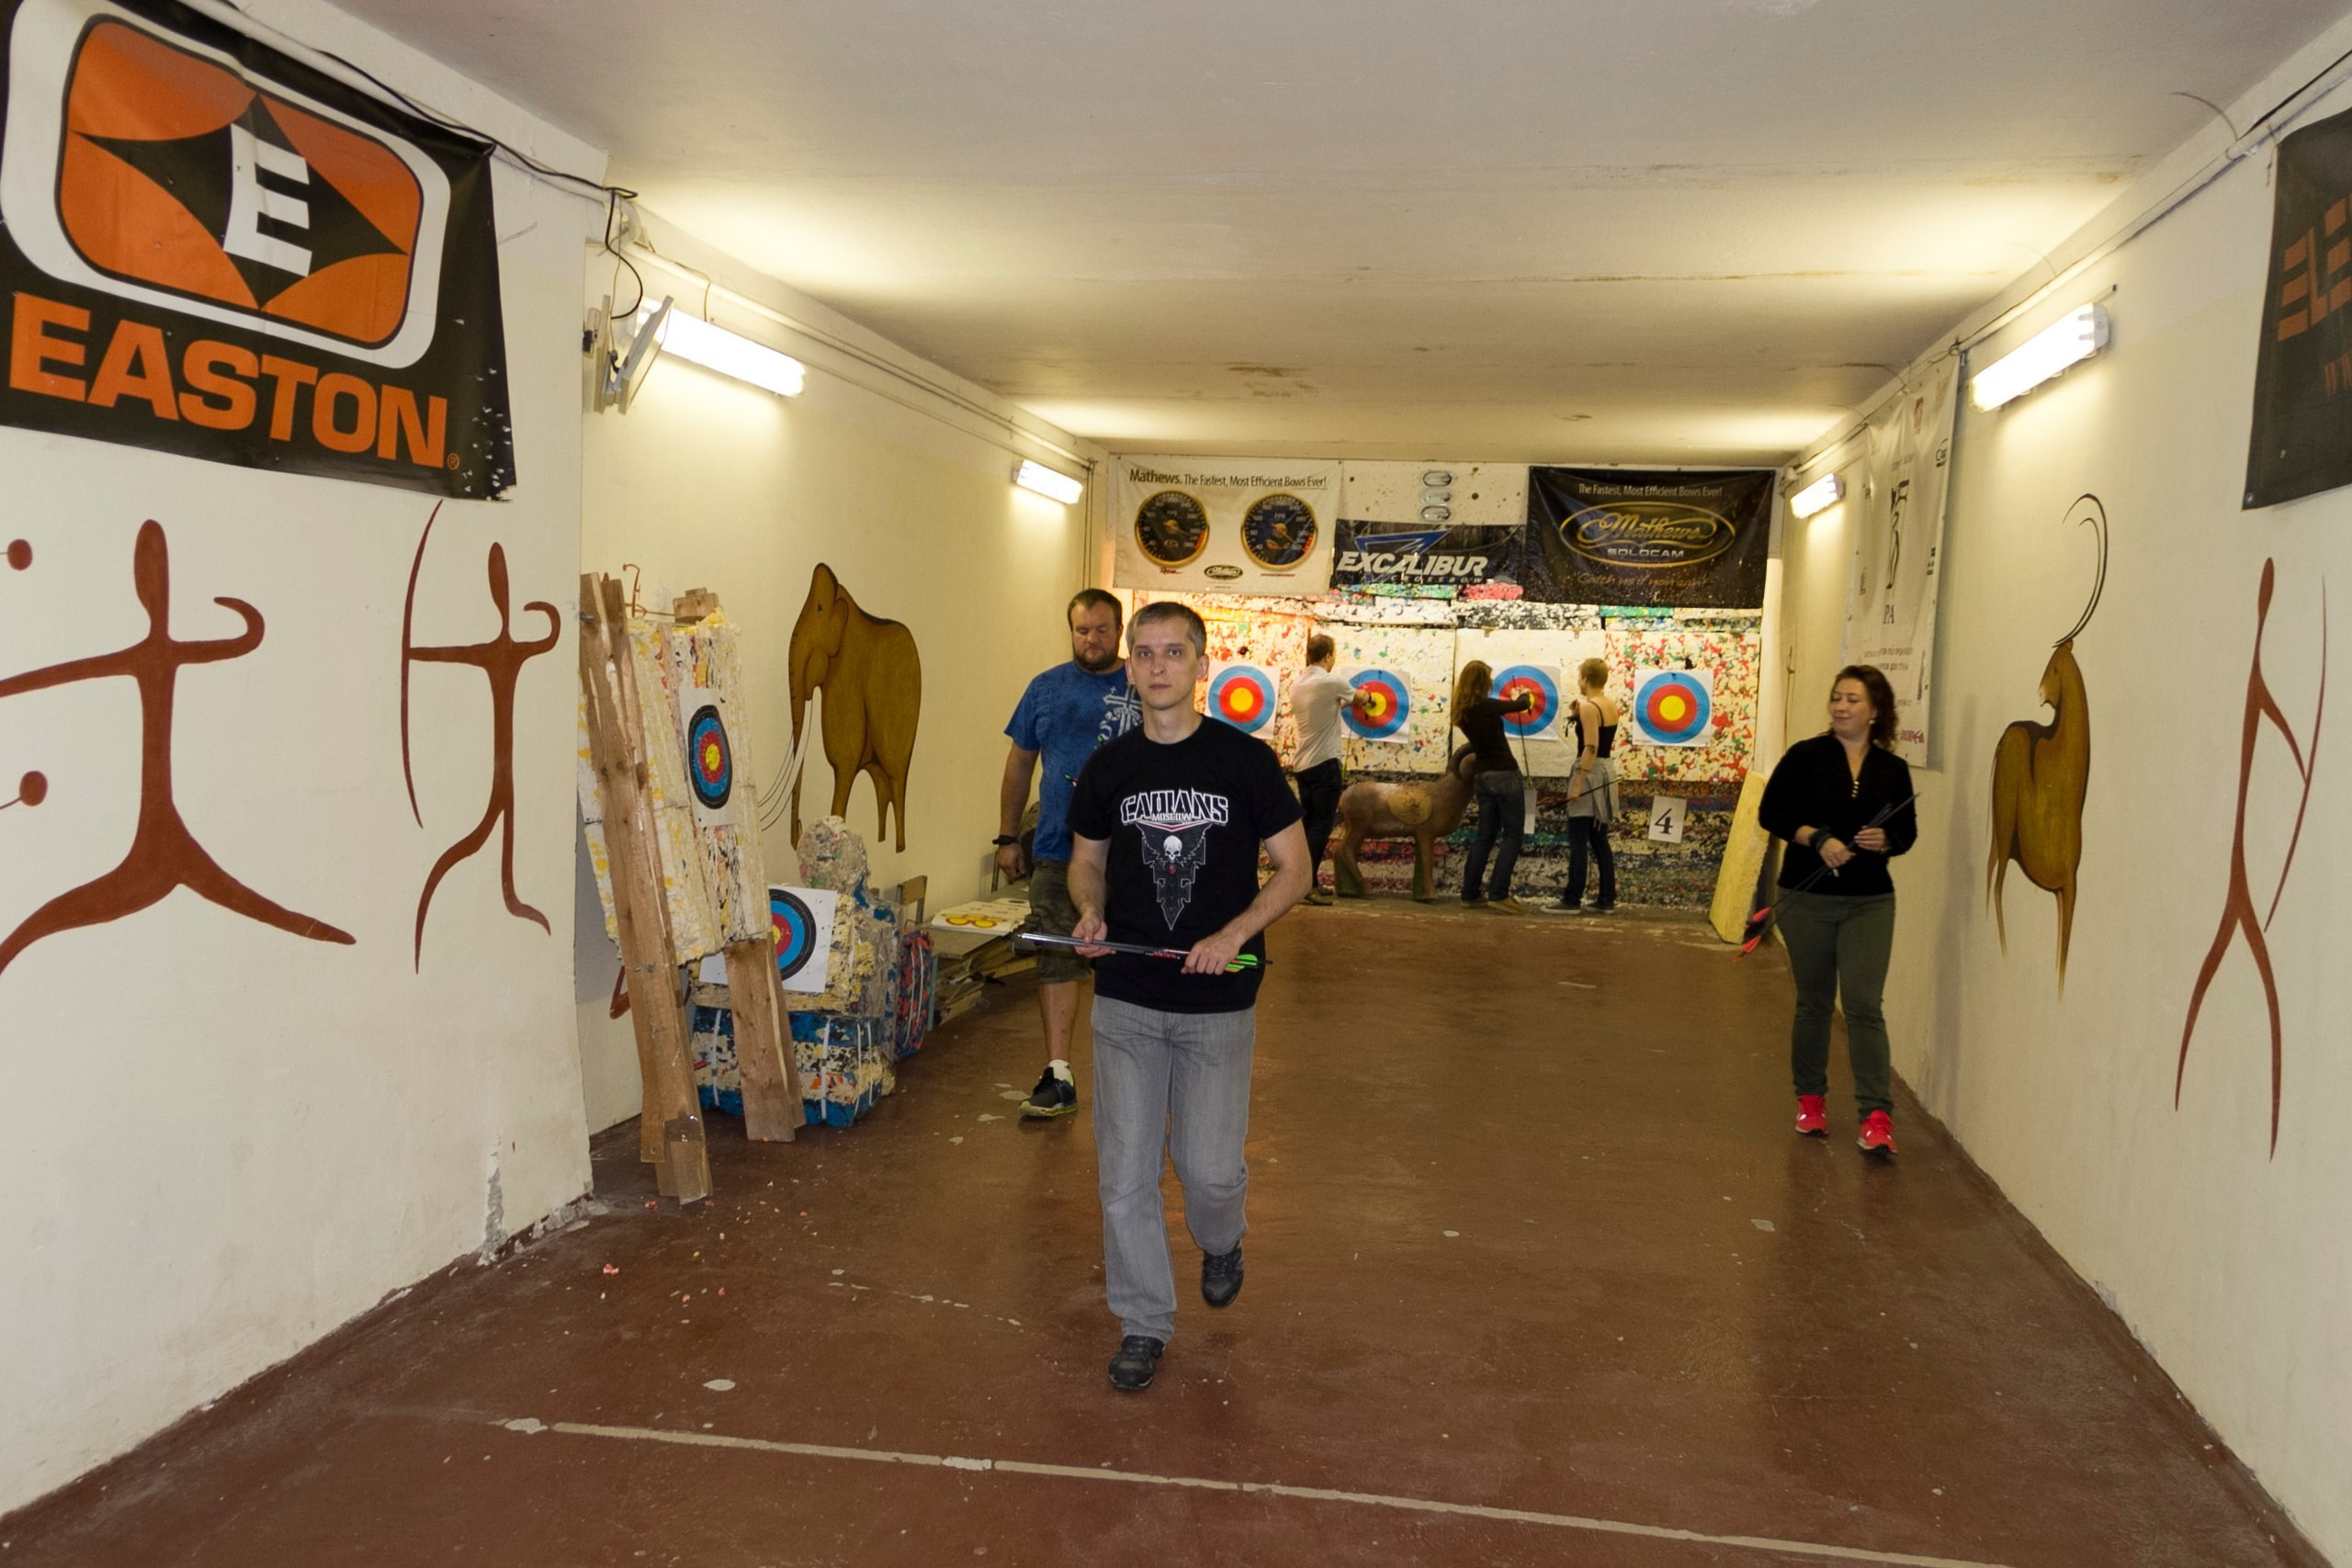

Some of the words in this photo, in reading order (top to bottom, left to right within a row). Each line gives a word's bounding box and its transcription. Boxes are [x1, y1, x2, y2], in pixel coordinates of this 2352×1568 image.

[223, 123, 312, 277] E
[9, 291, 447, 468] EASTON
[1129, 468, 1182, 484] Mathews.
[1184, 473, 1198, 485] The
[1200, 474, 1228, 487] Fastest,
[1229, 475, 1250, 487] Most
[1250, 476, 1283, 487] Efficient
[1284, 476, 1306, 487] Bows
[1306, 476, 1327, 487] Ever!
[1578, 483, 1592, 494] The
[1592, 484, 1622, 496] Fastest,
[1623, 485, 1644, 496] Most
[1645, 485, 1678, 496] Efficient
[1679, 486, 1702, 496] Bows
[1702, 486, 1723, 496] Ever!
[1607, 547, 1684, 558] SOLOCAM
[1337, 551, 1488, 576] EXCALIBUR
[1390, 574, 1484, 584] CROSSBOW
[1151, 812, 1193, 822] MOSCOW
[1655, 807, 1673, 834] 4
